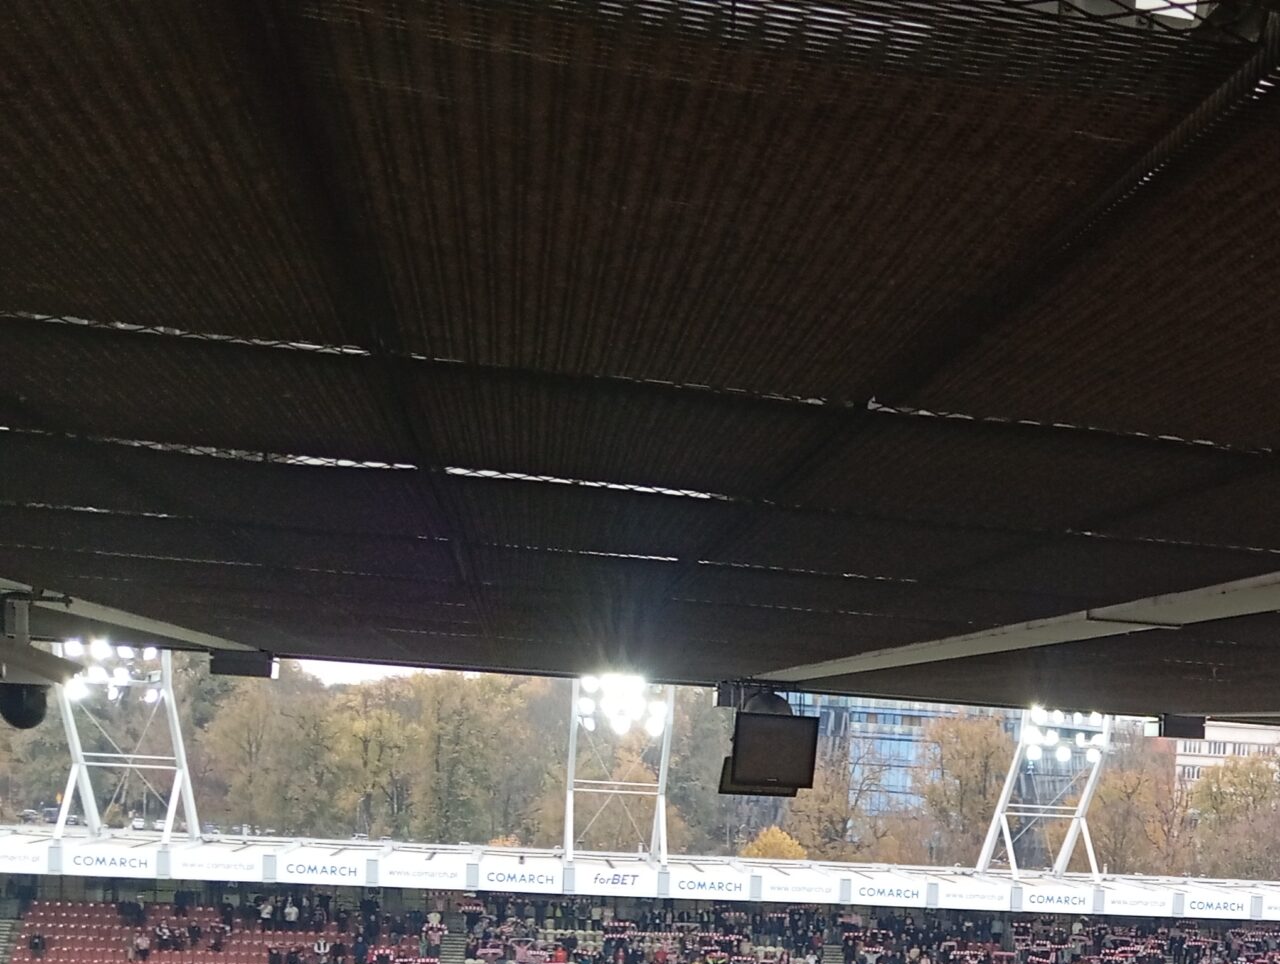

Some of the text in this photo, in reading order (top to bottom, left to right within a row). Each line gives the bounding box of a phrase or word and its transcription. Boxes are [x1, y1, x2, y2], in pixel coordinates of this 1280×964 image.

[73, 855, 148, 868] COMARCH
[286, 863, 358, 876] COMARCH
[487, 872, 554, 884] COMARCH
[593, 873, 639, 886] forBET
[678, 880, 742, 892] COMARCH
[858, 887, 919, 899] COMARCH
[1029, 894, 1086, 905] COMARCH
[1189, 901, 1244, 912] COMARCH
